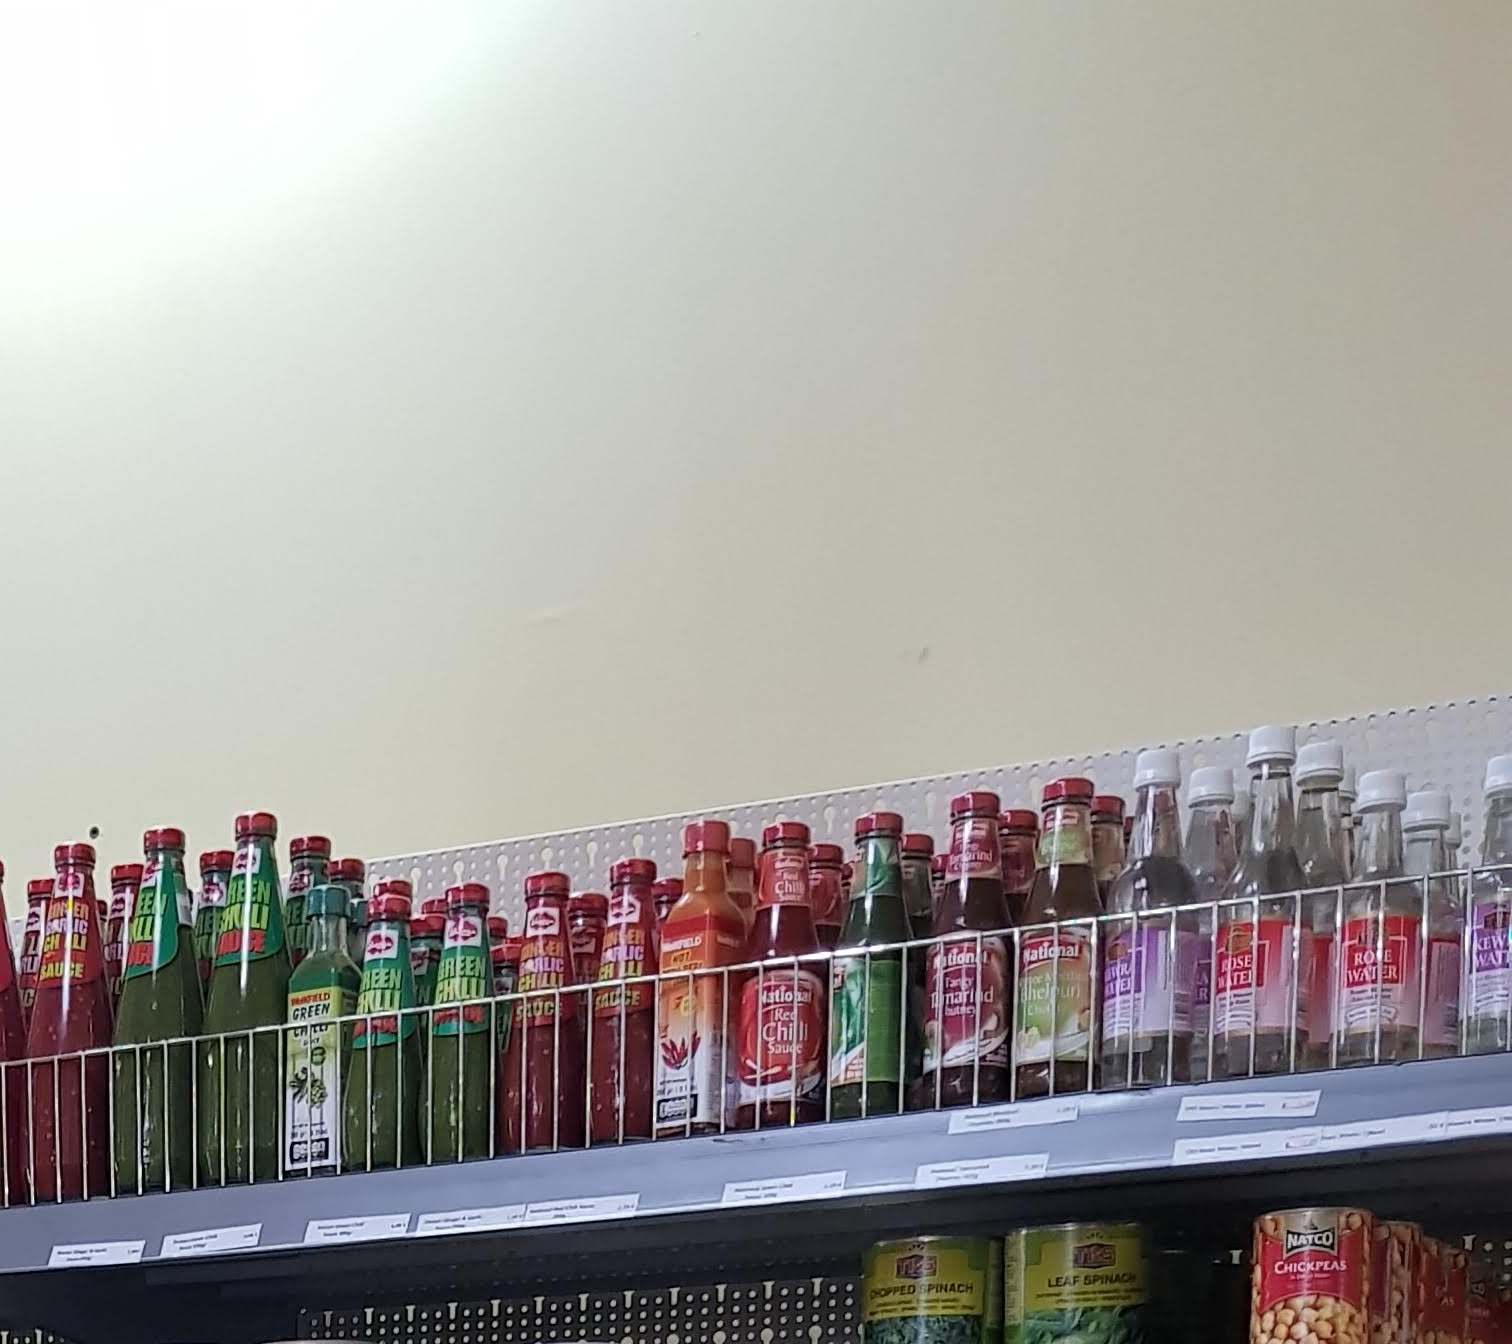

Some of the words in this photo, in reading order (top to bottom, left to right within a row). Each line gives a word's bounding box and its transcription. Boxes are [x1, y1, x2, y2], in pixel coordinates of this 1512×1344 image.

[932, 946, 988, 970] National
[1023, 941, 1080, 964] National
[39, 963, 85, 982] SAUCE
[438, 956, 487, 979] GREEN
[1220, 954, 1254, 975] ROSE
[1345, 964, 1400, 985] WATER
[944, 975, 976, 990] Tangy
[759, 984, 812, 1007] National
[292, 1001, 331, 1022] GREEN
[774, 1003, 800, 1022] Red
[761, 1021, 809, 1044] Chilli
[766, 1040, 804, 1056] Sauce
[1287, 1230, 1335, 1249] NATCO
[1274, 1258, 1348, 1277] CHICKPEAS
[868, 1281, 916, 1300] CHOPPED
[917, 1280, 975, 1296] SPINACH
[1046, 1273, 1082, 1289] LEAF
[1083, 1271, 1138, 1287] SPINACH
